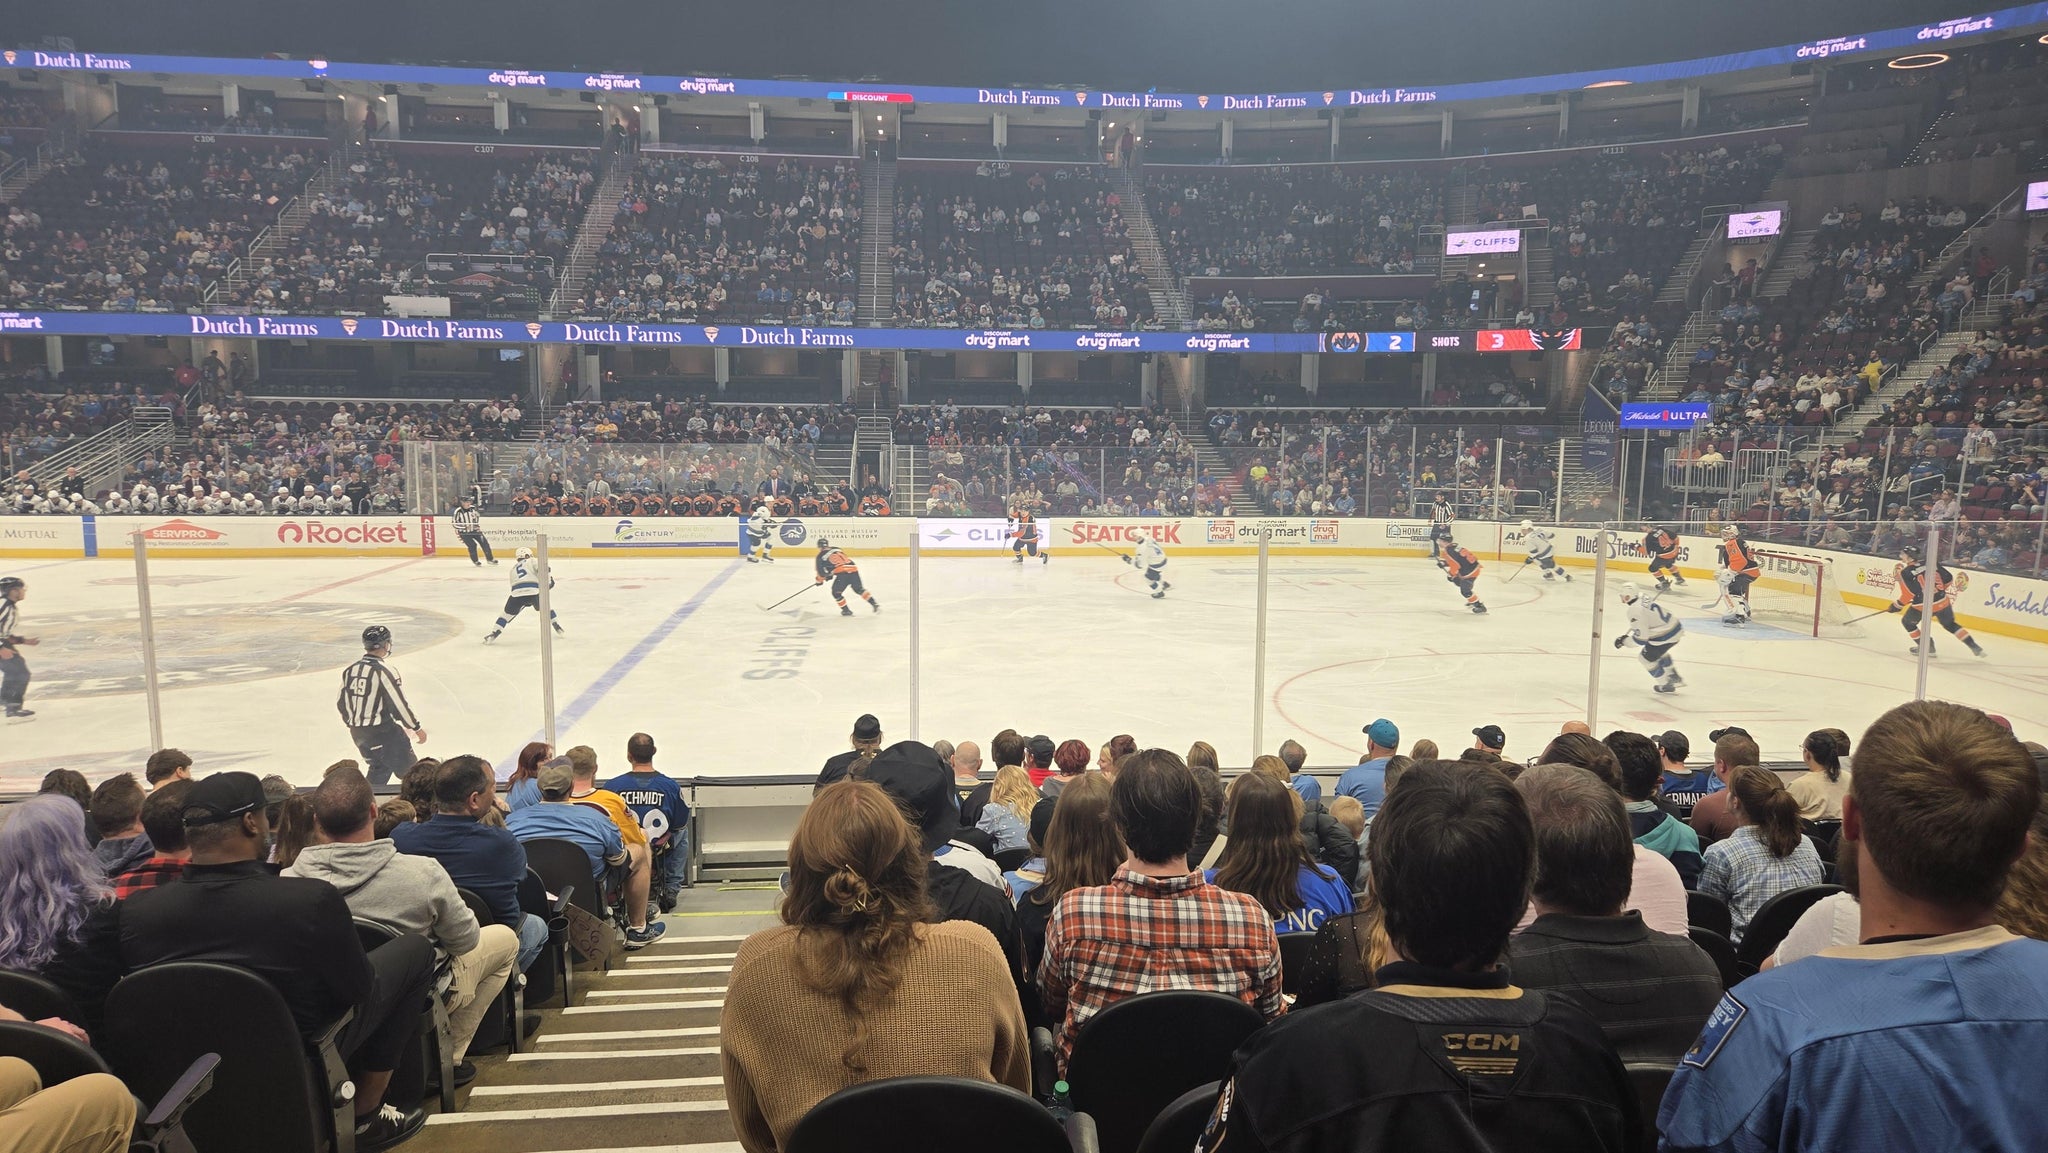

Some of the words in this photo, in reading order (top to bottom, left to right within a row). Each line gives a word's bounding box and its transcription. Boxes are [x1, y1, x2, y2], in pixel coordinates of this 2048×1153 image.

[1917, 24, 1954, 40] drug
[1955, 16, 1993, 33] mart
[1796, 44, 1829, 58] drug
[1831, 37, 1866, 52] mart
[34, 52, 81, 68] Dutch
[84, 53, 132, 69] Farms
[488, 72, 516, 88] drug
[517, 74, 546, 86] mart
[585, 76, 612, 90] drug
[614, 78, 640, 89] mart
[680, 80, 706, 94] drug
[708, 82, 734, 92] mart
[852, 94, 888, 102] DISCOUNT
[978, 90, 1018, 104] Dutch
[1021, 90, 1060, 105] Farms
[1102, 93, 1141, 108] Dutch
[1144, 94, 1182, 108] Farms
[1224, 95, 1262, 109] Dutch
[1266, 95, 1307, 108] Farms
[1350, 91, 1391, 105] Dutch
[1395, 89, 1436, 103] Farms
[1737, 227, 1770, 235] CLIFFS
[1474, 238, 1516, 246] CLIFFS
[4, 316, 42, 328] mart
[192, 316, 252, 334] Dutch
[258, 317, 318, 336] Farms
[381, 320, 440, 338] Dutch
[446, 322, 503, 340] Farms
[564, 324, 620, 342] Dutch
[626, 325, 682, 343] Farms
[741, 327, 795, 345] Dutch
[800, 328, 854, 346] Farms
[965, 332, 996, 348] drug
[998, 335, 1030, 346] mart
[1076, 334, 1107, 350] drug
[1109, 336, 1140, 348] mart
[1186, 335, 1216, 351] drug
[1218, 337, 1250, 349] mart
[1390, 336, 1402, 350] 2
[1432, 336, 1460, 346] SHOTS
[1492, 334, 1504, 348] 3
[1670, 412, 1708, 420] ULTRA
[1584, 421, 1614, 434] LECOM
[4, 530, 58, 538] MUTUAL
[152, 530, 206, 538] SERVPRO
[307, 520, 408, 544] Rocket
[424, 518, 432, 550] CCM
[1210, 524, 1230, 534] drug
[1238, 526, 1272, 539] drug
[1275, 526, 1306, 536] mart
[1312, 524, 1334, 534] drug
[1576, 536, 1599, 554] Blue
[516, 564, 527, 578] 5
[1650, 602, 1672, 623] 2
[350, 678, 366, 695] 49
[620, 791, 664, 806] SCHMIDT
[1441, 1033, 1520, 1050] CCM
